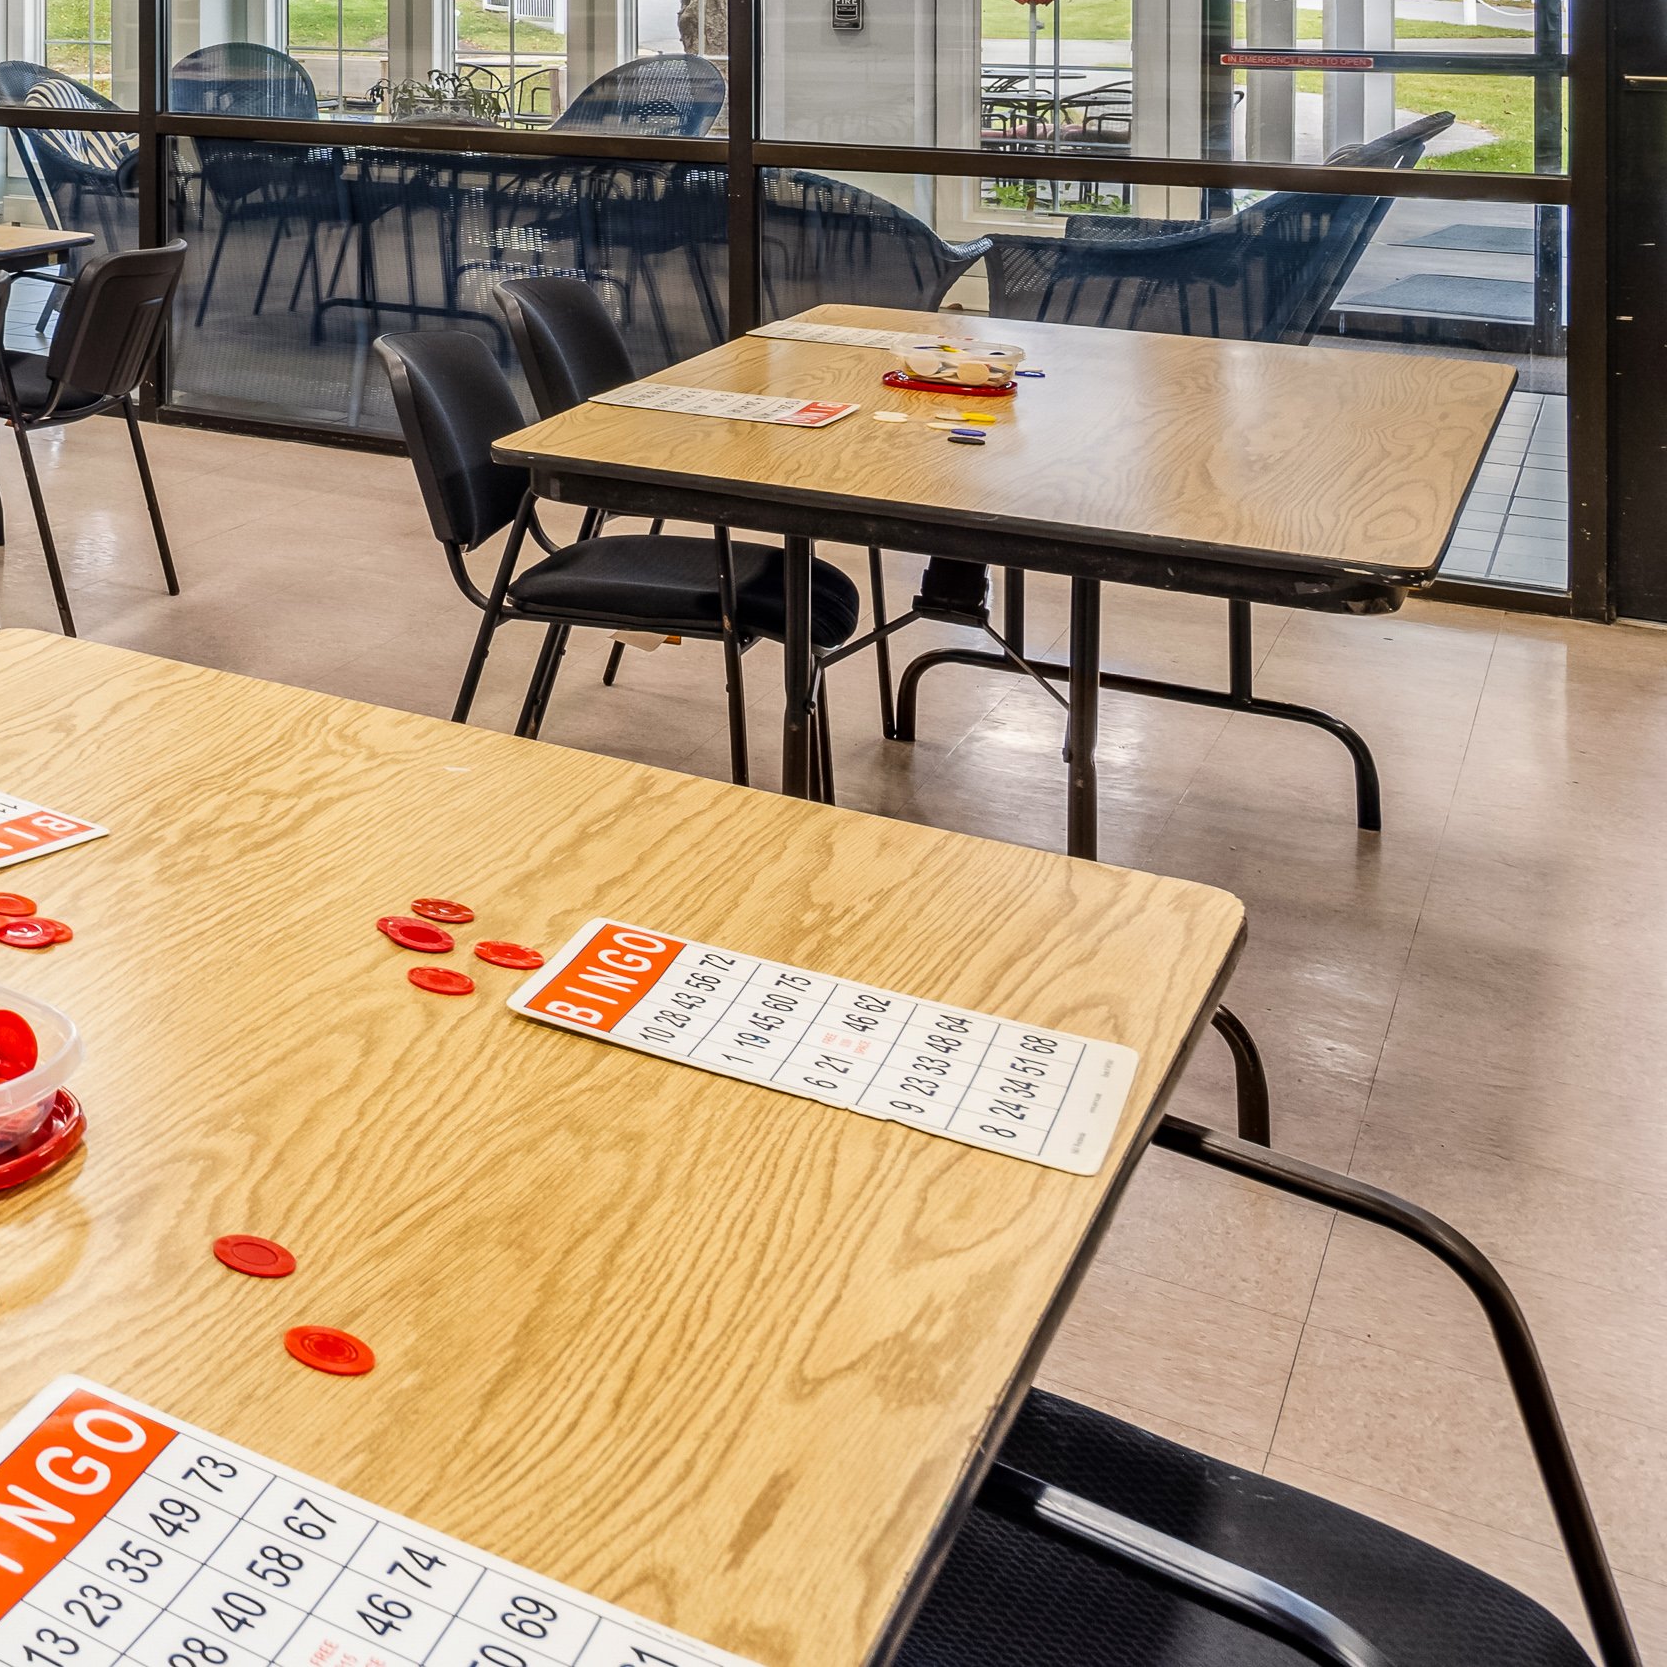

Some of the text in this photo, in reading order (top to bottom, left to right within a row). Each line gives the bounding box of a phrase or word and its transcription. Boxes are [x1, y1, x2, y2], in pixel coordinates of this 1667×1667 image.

[1227, 55, 1367, 66] IN EMERGENCY PUSH TO OPEN
[544, 931, 668, 1027] BINGO
[638, 953, 735, 1043] 10 28 43 56 72
[721, 973, 811, 1063] 1 19 45 60 75
[841, 994, 890, 1031] 46 62
[802, 1054, 852, 1088] 6 21
[889, 1014, 972, 1113] 9 23 33 48 64
[979, 1035, 1057, 1138] 8 24 34 51 68
[22, 1455, 237, 1667] 13 23 35 49 73
[211, 1592, 266, 1632] 40
[246, 1545, 303, 1587] 58
[283, 1498, 336, 1539] 67
[356, 1546, 446, 1635] 46 74
[469, 1596, 557, 1667] 0 69
